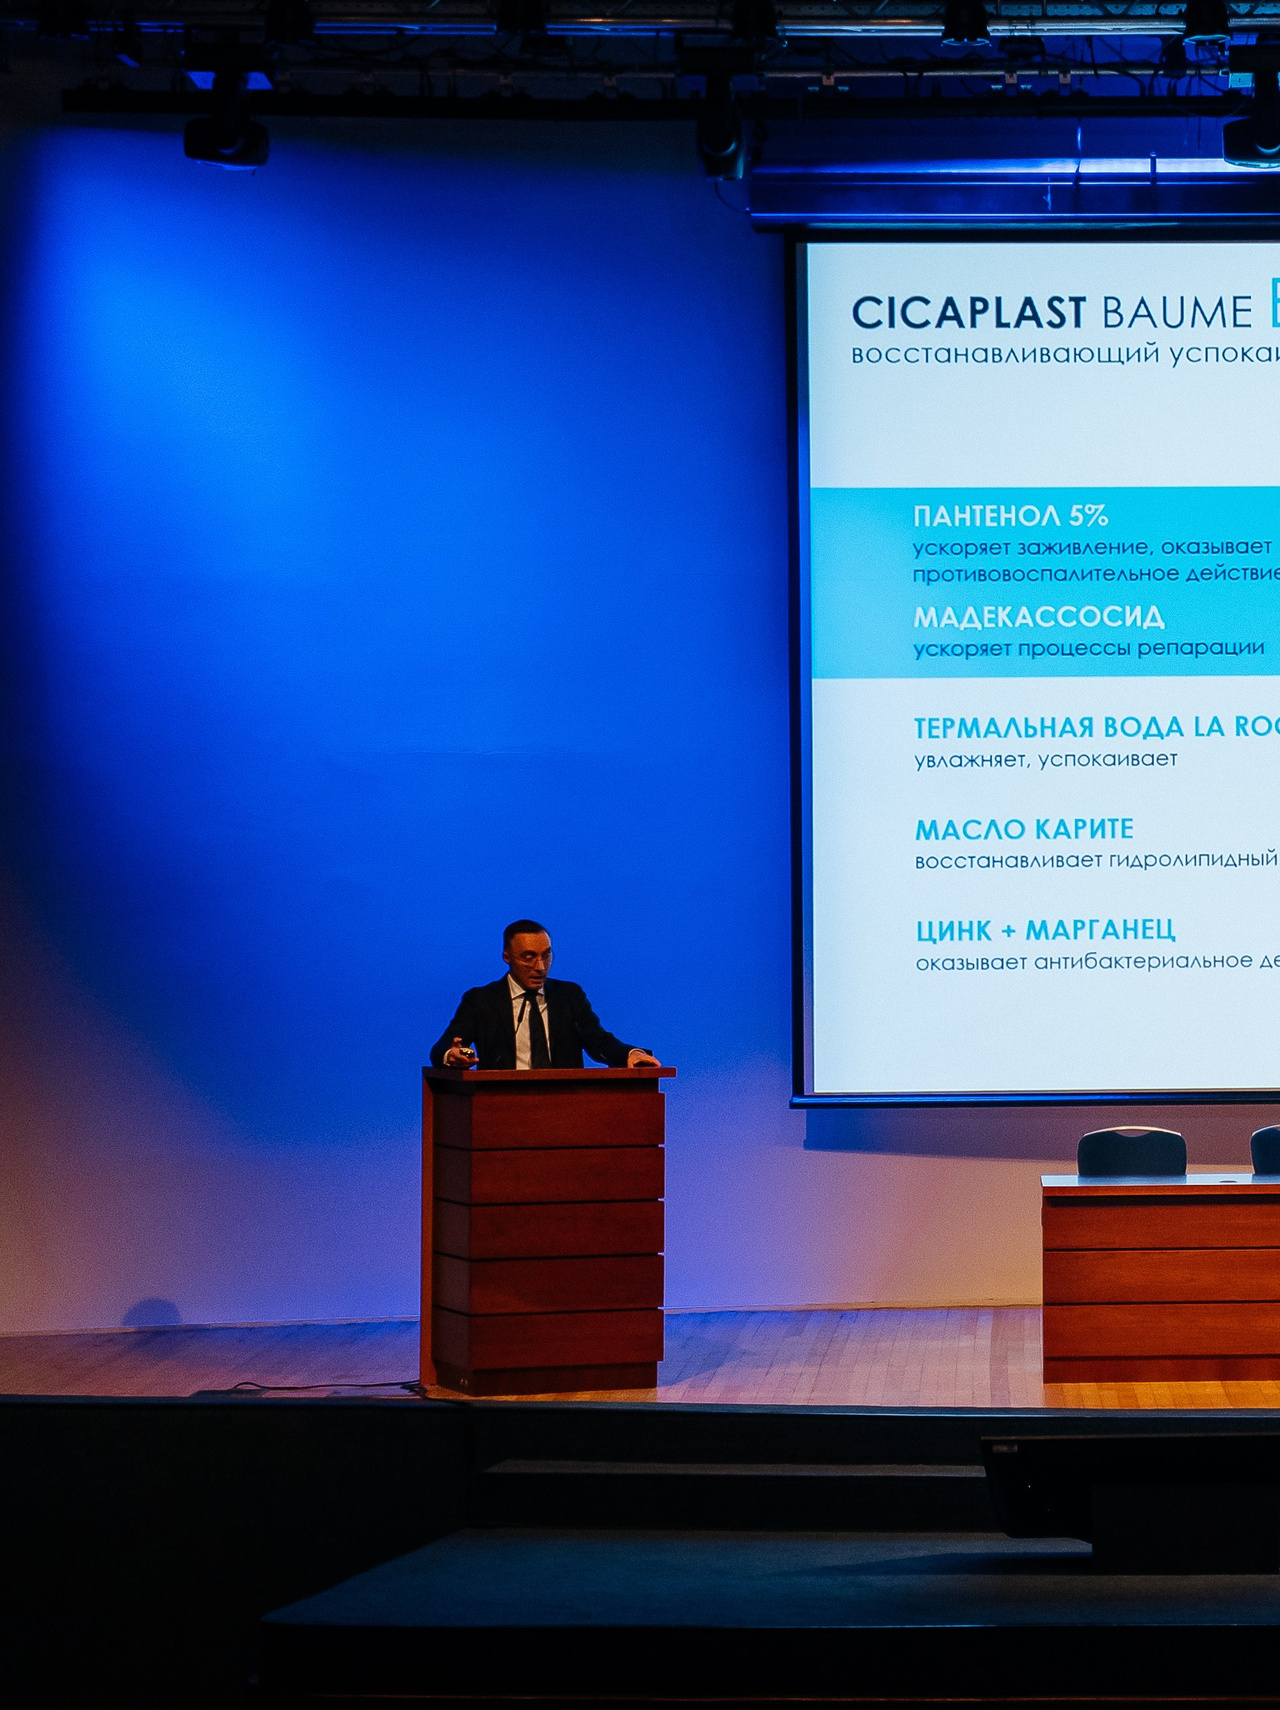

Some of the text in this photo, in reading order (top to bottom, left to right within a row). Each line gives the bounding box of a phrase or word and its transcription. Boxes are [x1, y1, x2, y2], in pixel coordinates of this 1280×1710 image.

[853, 296, 1086, 329] CICAPLAST
[1104, 296, 1251, 329] BAUME
[852, 342, 1159, 365] восстанавливающий
[914, 504, 1109, 527] ПАНТЕНОЛ 5%
[913, 540, 1272, 560] ускоряет заживление, оказывает
[912, 566, 1180, 585] противовоспалительное
[913, 605, 1166, 631] МАДЕКАССОСИД
[914, 642, 1264, 660] ускоряет процессы репарации
[914, 717, 1093, 739] ТЕРМАЛЬНАЯ
[1105, 716, 1184, 740] ВОДА
[1195, 716, 1225, 737] LA
[915, 753, 1178, 771] увлажняет, успокаивает
[916, 818, 1133, 840] МАСЛО КАРИТЕ
[916, 855, 1102, 869] восстанавливает
[1110, 849, 1277, 871] гидролипидный
[917, 920, 992, 945] ЦИНК
[1026, 919, 1176, 942] МАРГАНЕЦ
[916, 956, 1028, 972] оказывает
[1034, 952, 1253, 972] антибактериальное
